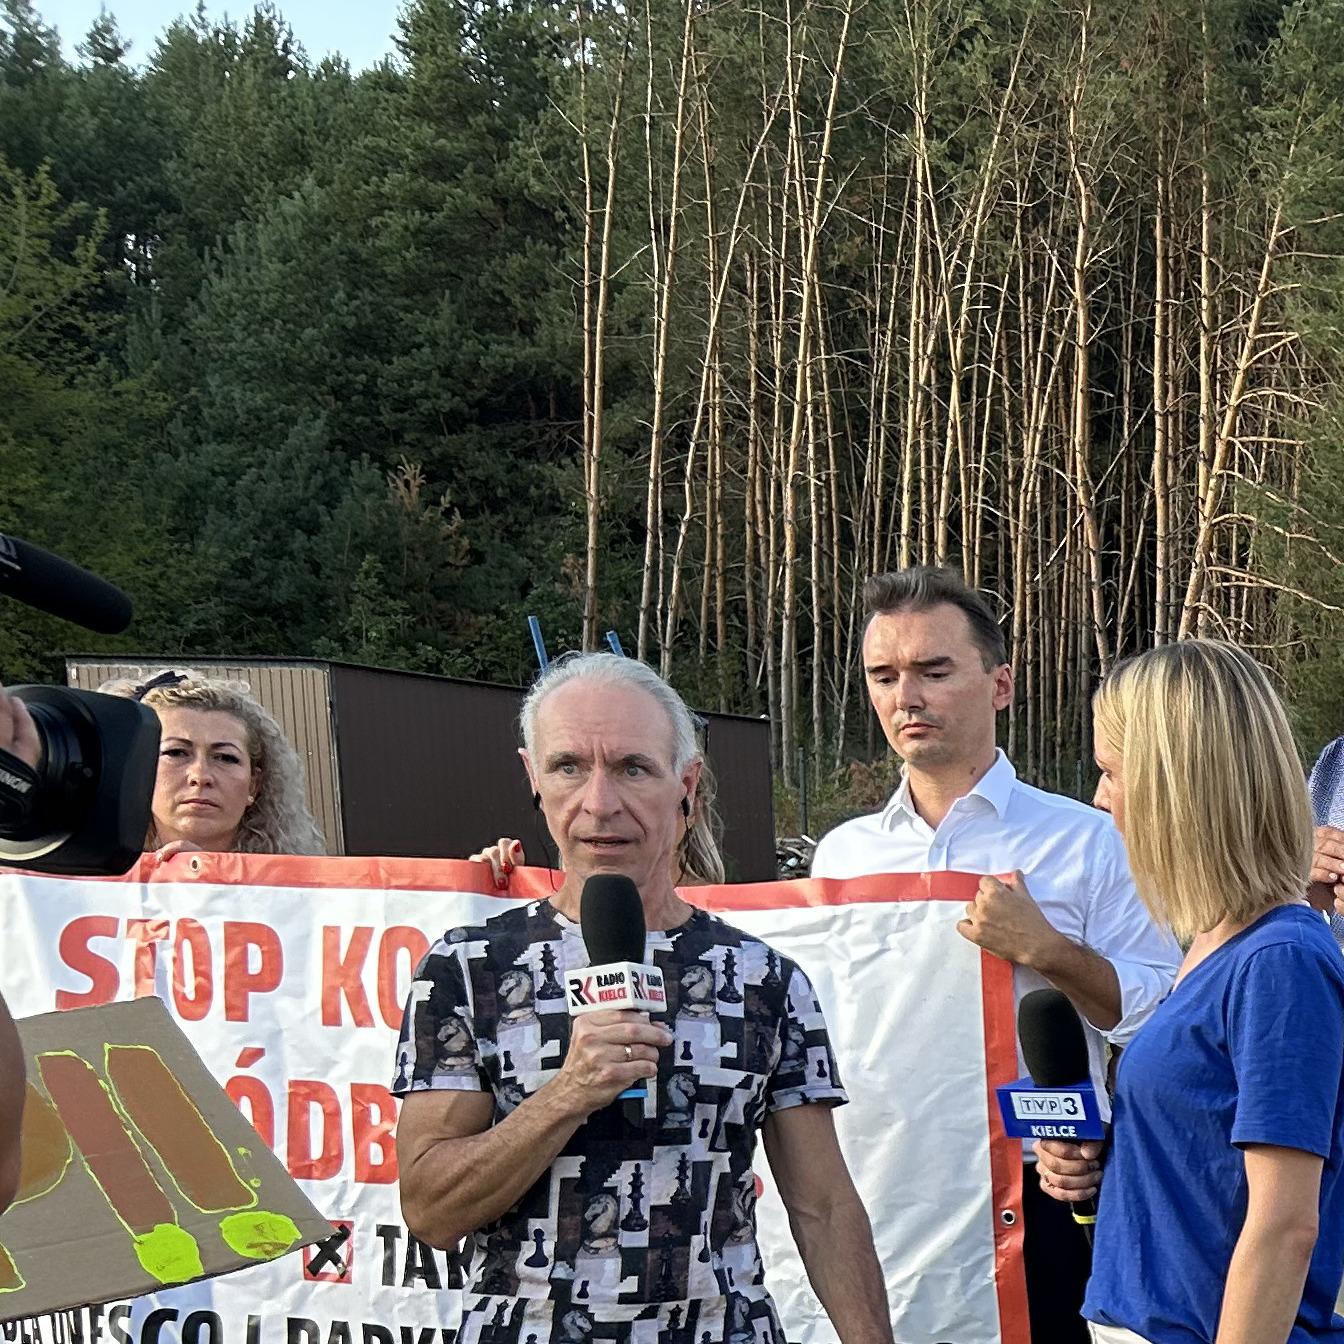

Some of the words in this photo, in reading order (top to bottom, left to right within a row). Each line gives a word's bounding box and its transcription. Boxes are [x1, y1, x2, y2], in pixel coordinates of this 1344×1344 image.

[55, 915, 284, 1023] STOP
[321, 924, 430, 1031] KO
[596, 972, 625, 987] RADIO
[1030, 1125, 1078, 1138] KIELCE
